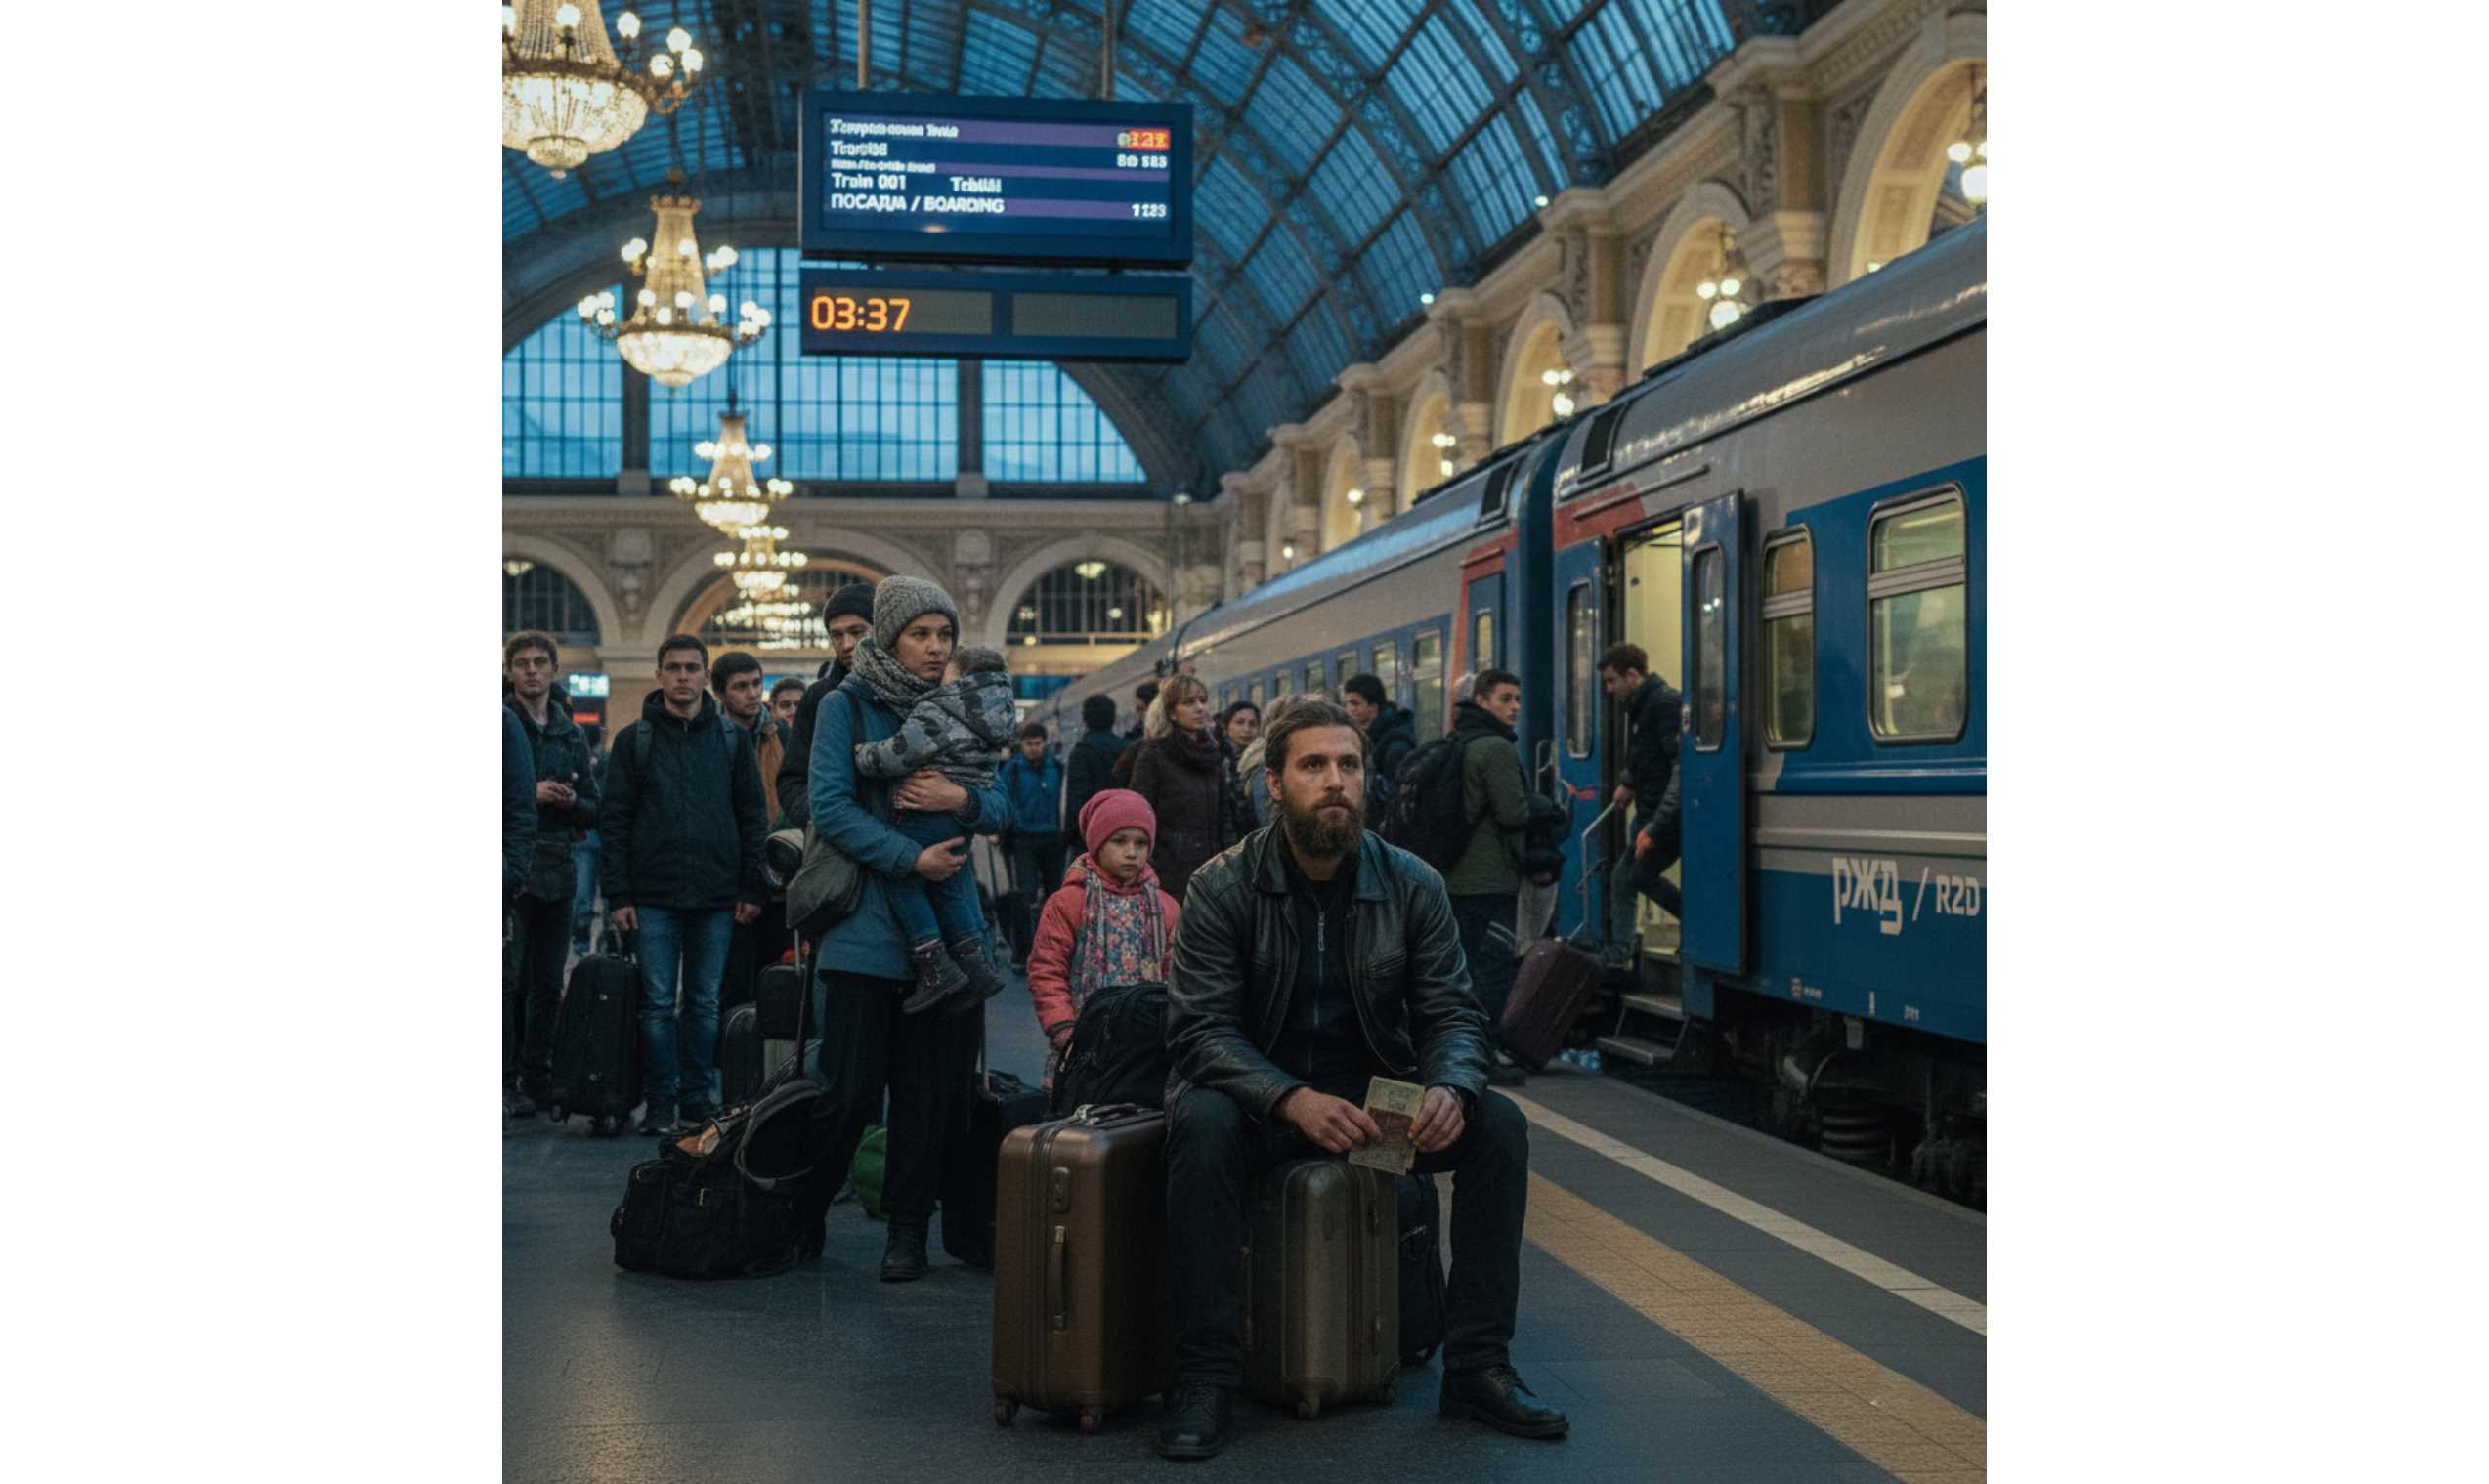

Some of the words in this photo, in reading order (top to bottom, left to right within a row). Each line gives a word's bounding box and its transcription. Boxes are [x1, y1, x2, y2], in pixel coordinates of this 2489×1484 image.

[831, 172, 874, 189] Train
[878, 174, 907, 191] 001
[923, 195, 1006, 213] BOARDING
[810, 295, 911, 331] 03:37
[1936, 874, 1981, 917] R2D
